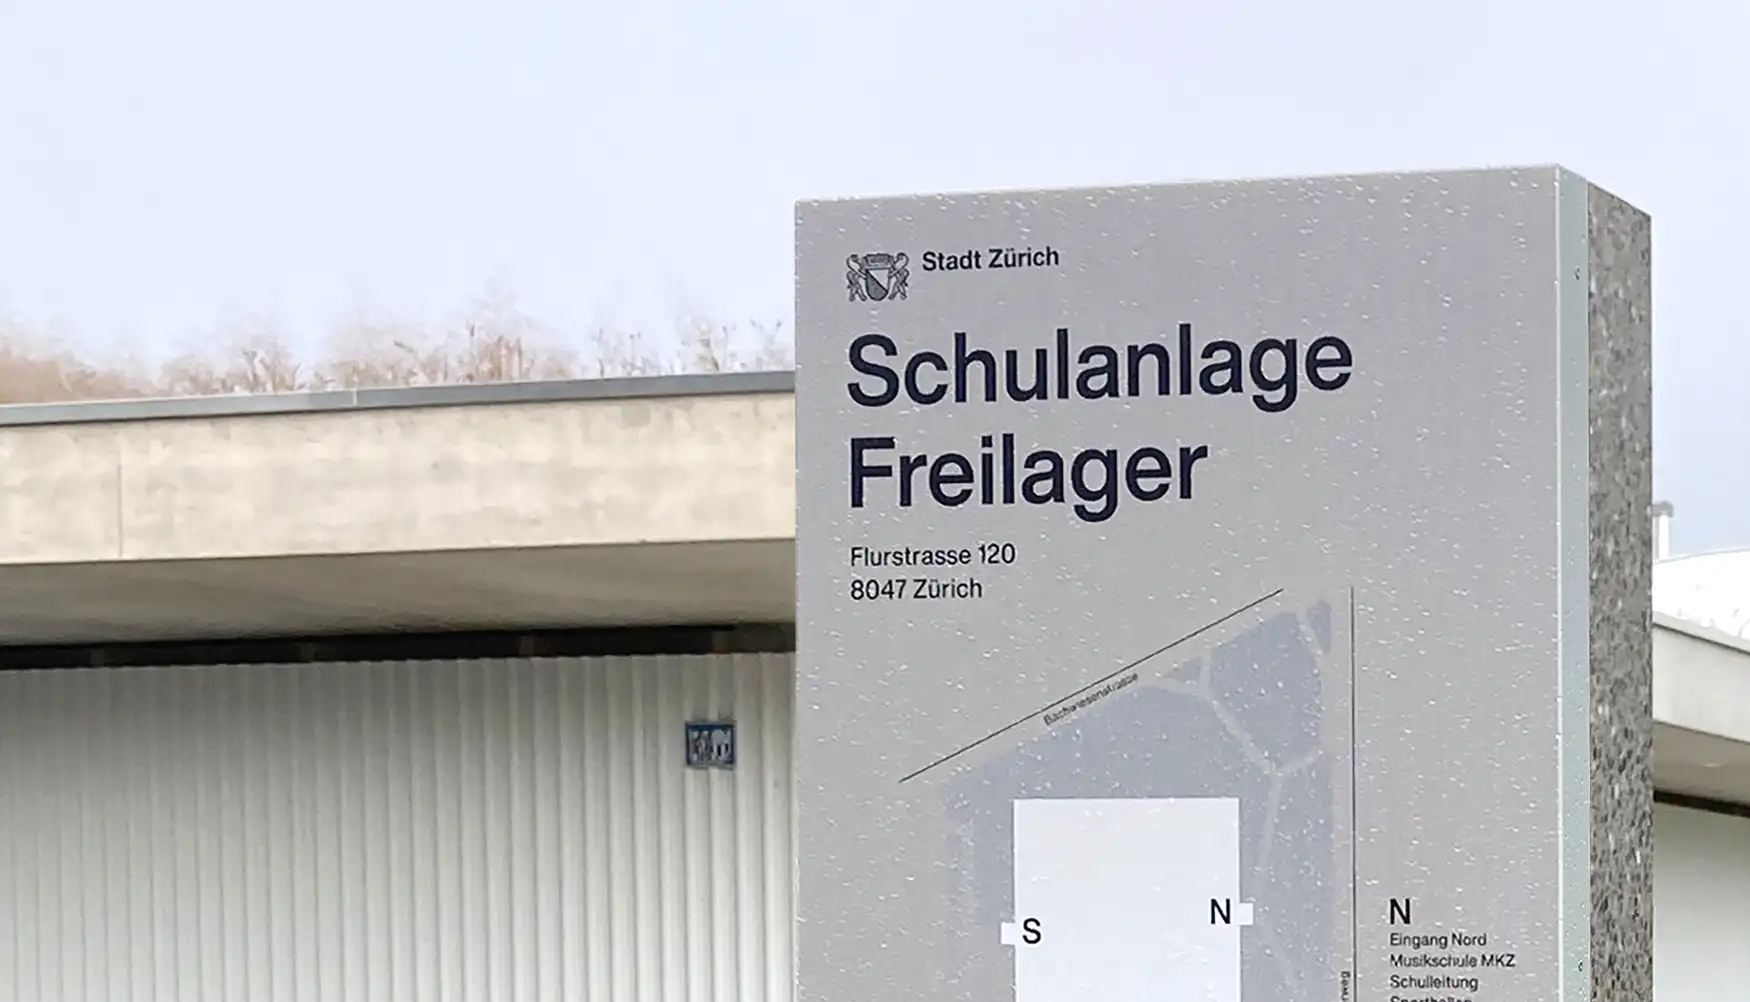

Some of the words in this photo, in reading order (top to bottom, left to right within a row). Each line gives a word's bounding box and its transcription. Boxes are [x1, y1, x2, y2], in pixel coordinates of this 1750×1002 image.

[922, 250, 982, 272] Stadt
[988, 247, 1059, 270] Zürich
[847, 323, 1353, 413] Schulanlage
[850, 432, 1208, 523] Freilager
[850, 546, 972, 567] Flurstrasse
[978, 543, 1016, 565] 120
[850, 579, 907, 601] 8047
[913, 577, 982, 599] Zürich
[1210, 898, 1231, 925] N
[1389, 898, 1411, 925] N
[1022, 917, 1042, 945] S
[1390, 932, 1448, 950] Eingang
[1451, 932, 1487, 947] Nord
[1390, 954, 1478, 968] Musikschule
[1481, 953, 1515, 968] MKZ
[1390, 974, 1479, 992] Schulleitung
